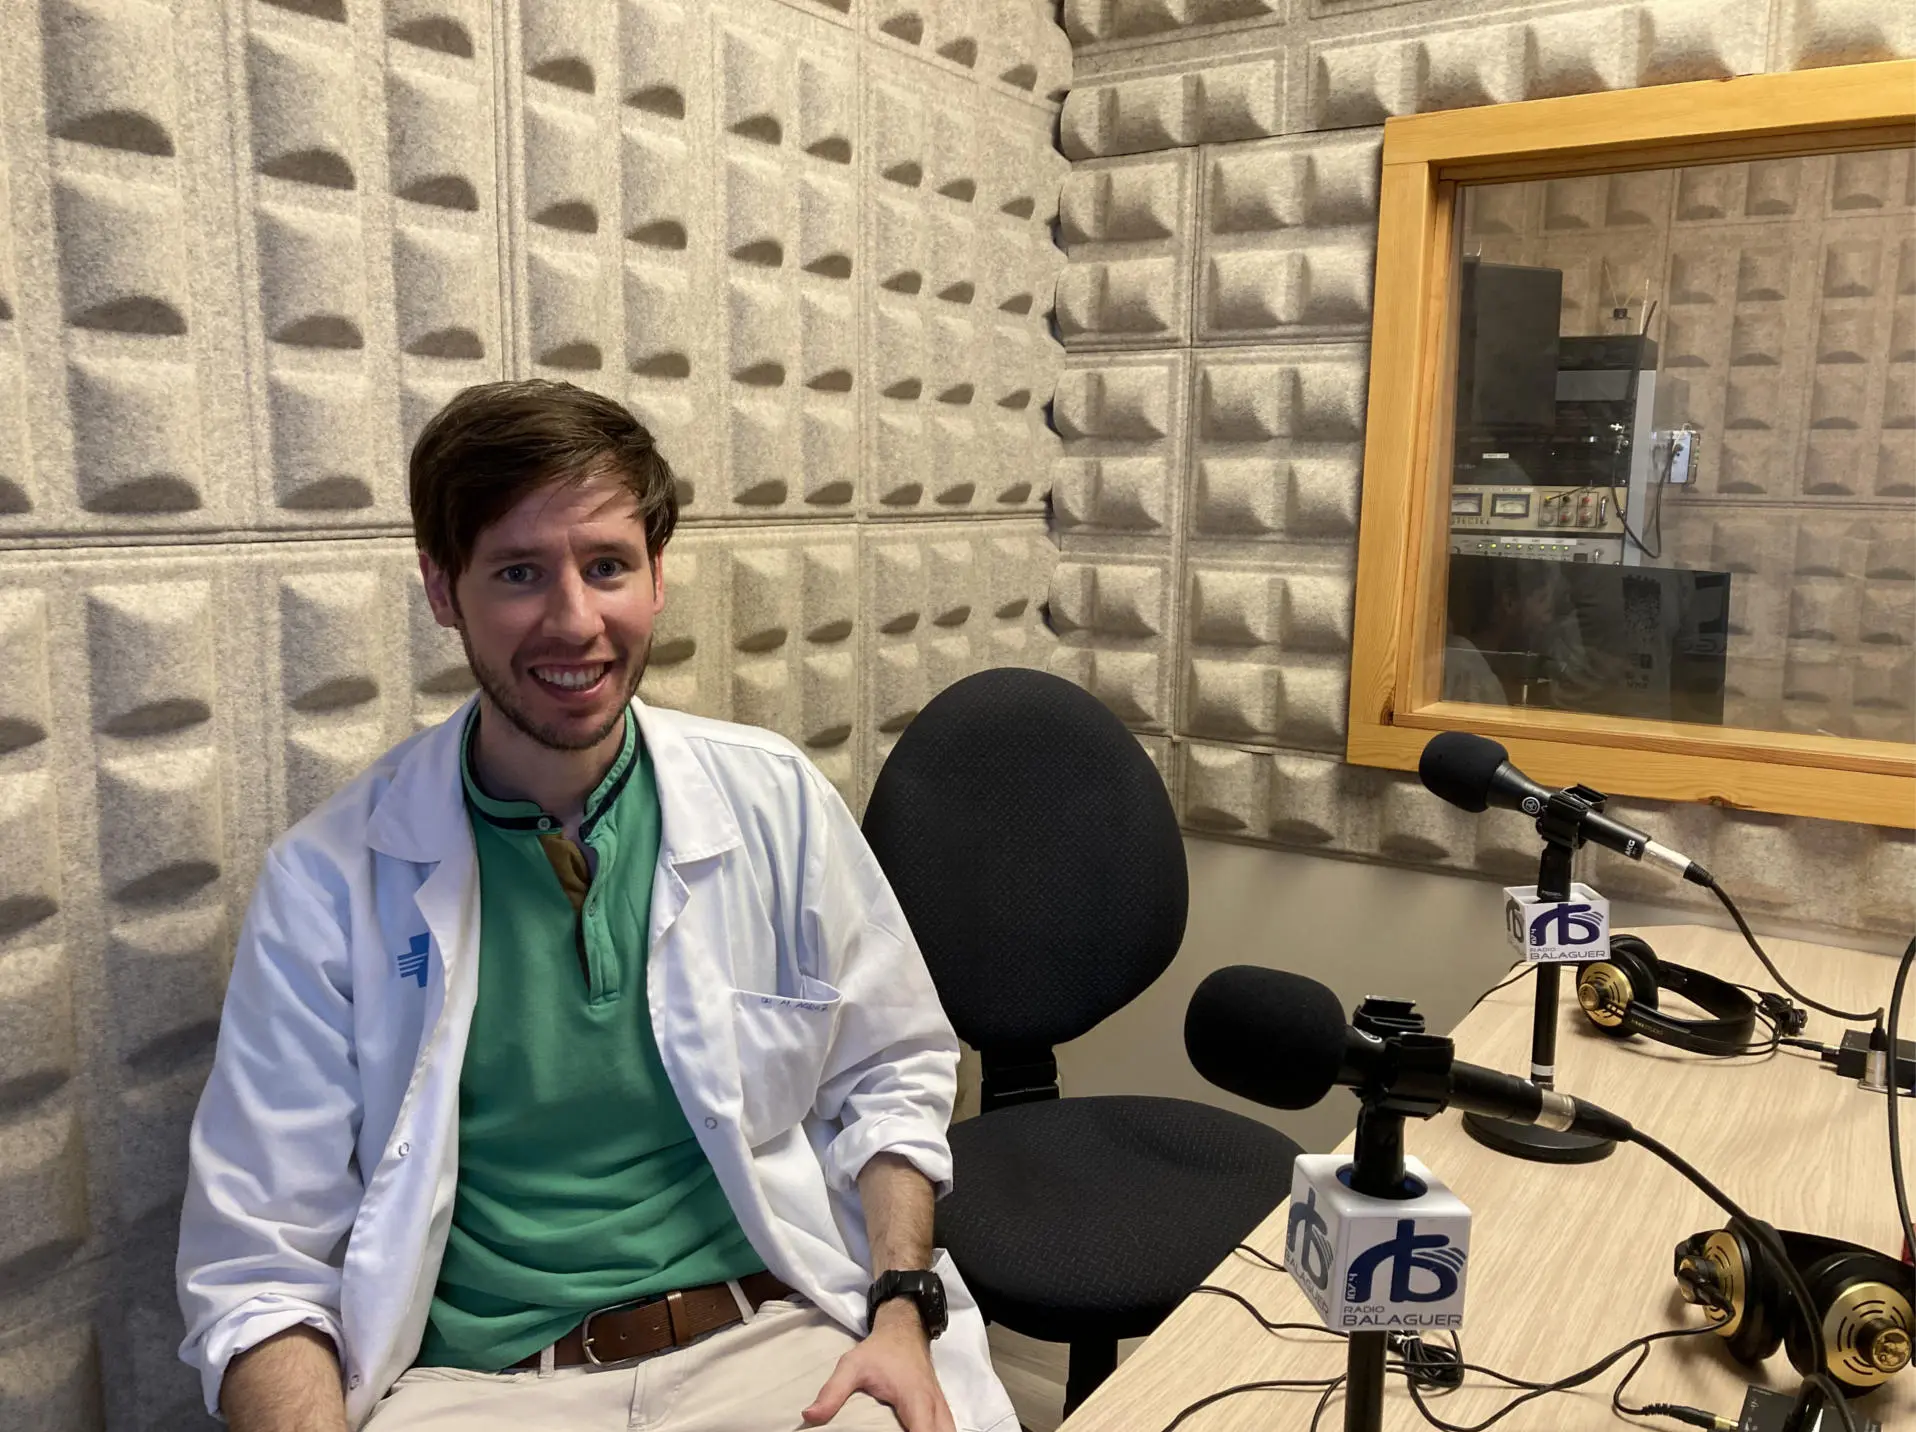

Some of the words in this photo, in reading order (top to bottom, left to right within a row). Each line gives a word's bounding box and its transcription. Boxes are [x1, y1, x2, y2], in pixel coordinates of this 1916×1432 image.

[1530, 950, 1606, 960] BALAGUER
[1343, 1305, 1385, 1314] RADIO
[1342, 1313, 1462, 1327] BALAGUER
